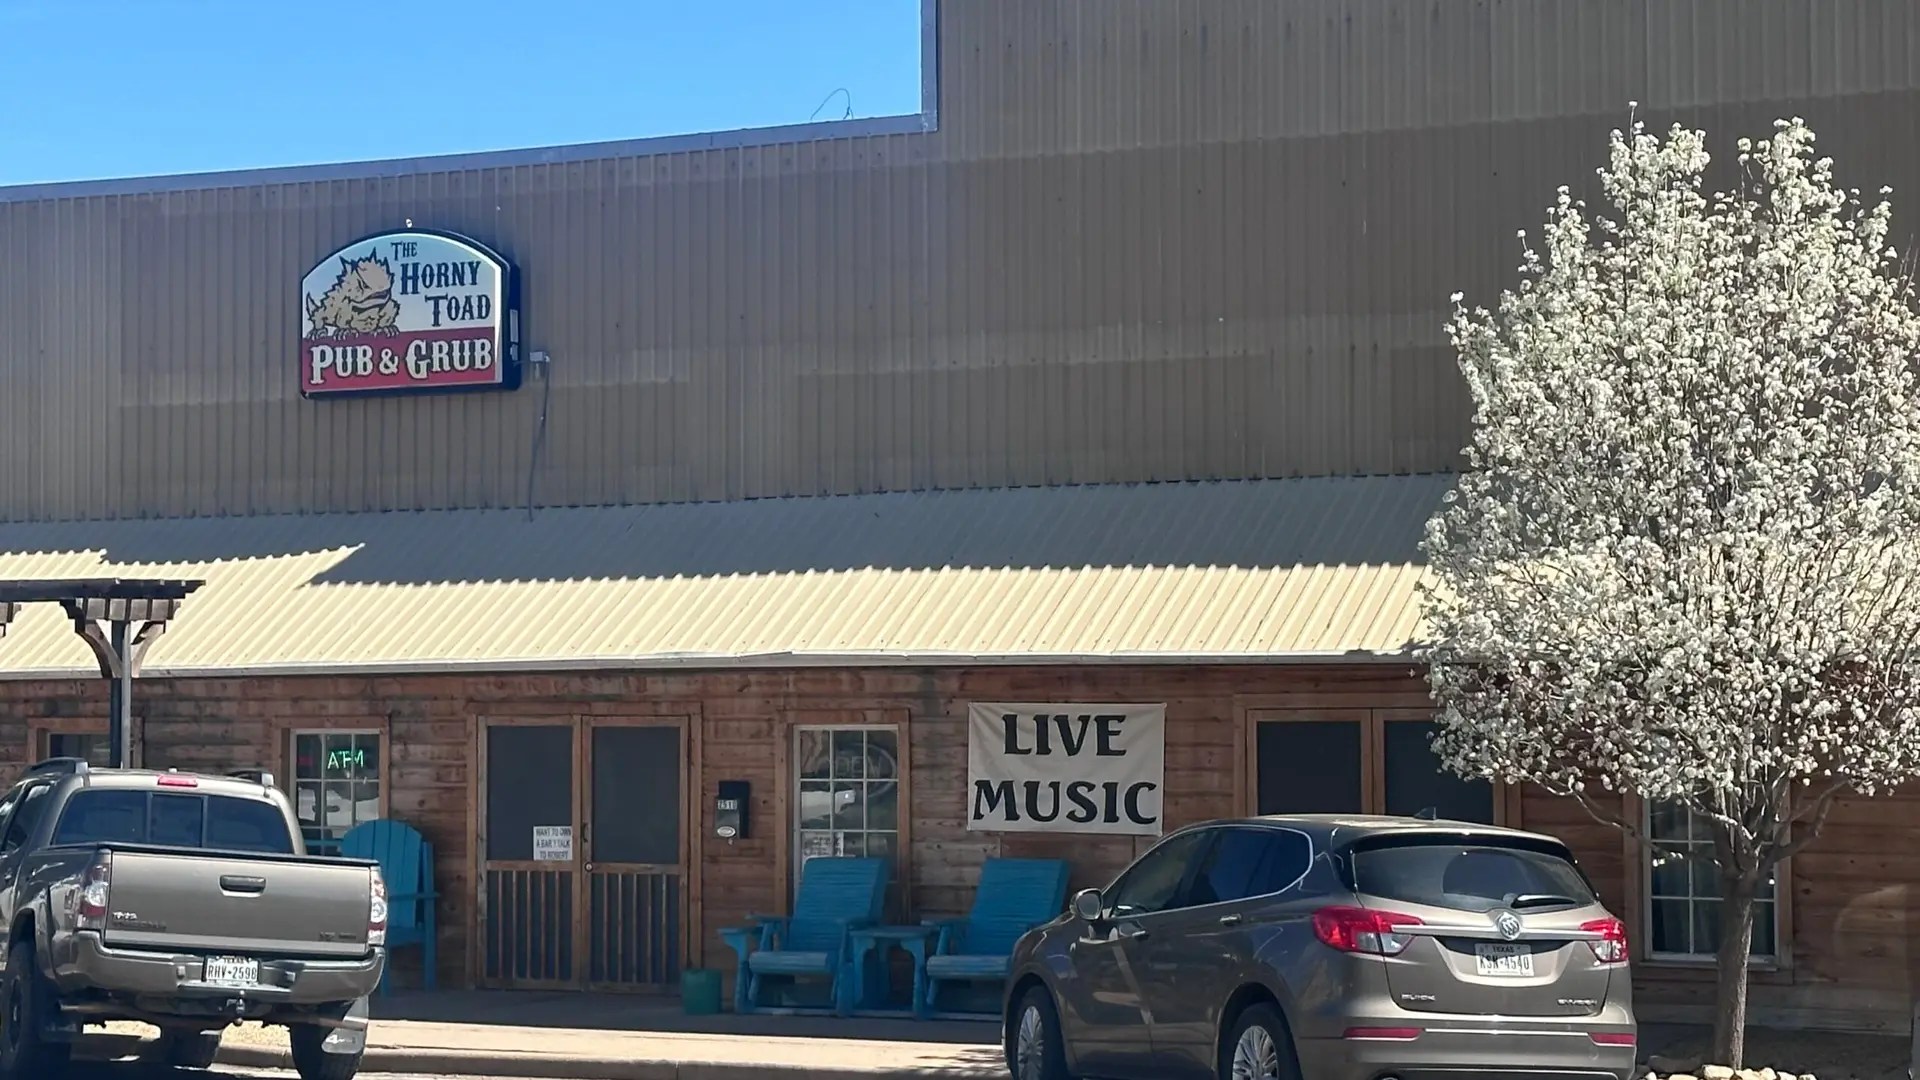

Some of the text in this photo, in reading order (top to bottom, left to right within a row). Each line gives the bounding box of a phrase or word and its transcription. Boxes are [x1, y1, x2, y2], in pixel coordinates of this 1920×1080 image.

[390, 241, 418, 262] THE
[400, 261, 482, 296] HORNY
[424, 294, 491, 328] TOAD
[309, 338, 493, 385] PUB & GRUB
[1002, 713, 1127, 757] LIVE
[327, 749, 364, 769] ATM
[973, 779, 1158, 825] MUSIC
